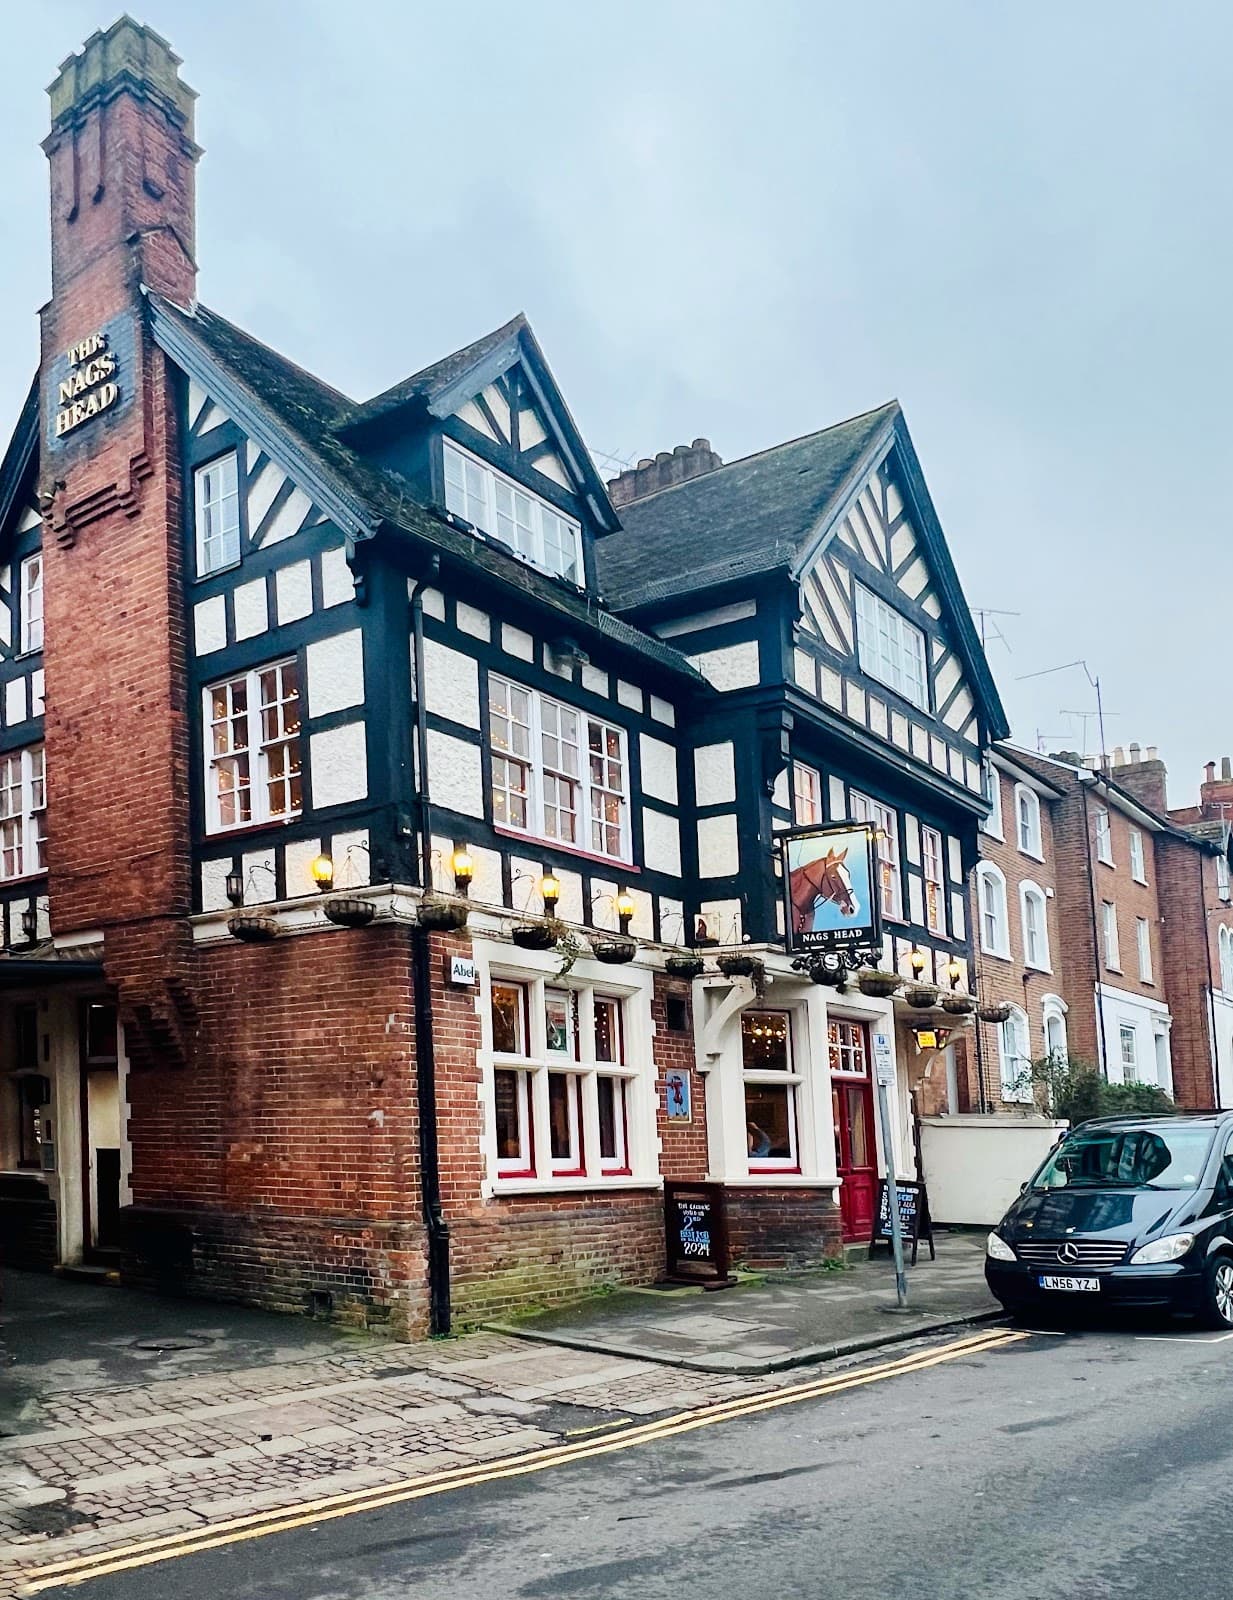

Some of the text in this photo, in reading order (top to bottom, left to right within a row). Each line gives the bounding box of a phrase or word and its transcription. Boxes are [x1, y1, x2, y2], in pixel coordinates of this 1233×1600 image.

[68, 332, 107, 367] THE
[58, 351, 116, 405] NAGS
[56, 383, 119, 438] HEAD
[802, 929, 863, 943] NAGS HEAD
[453, 963, 474, 978] Abel
[683, 1242, 710, 1257] 2024
[1045, 1278, 1099, 1290] LN56 YZJ
